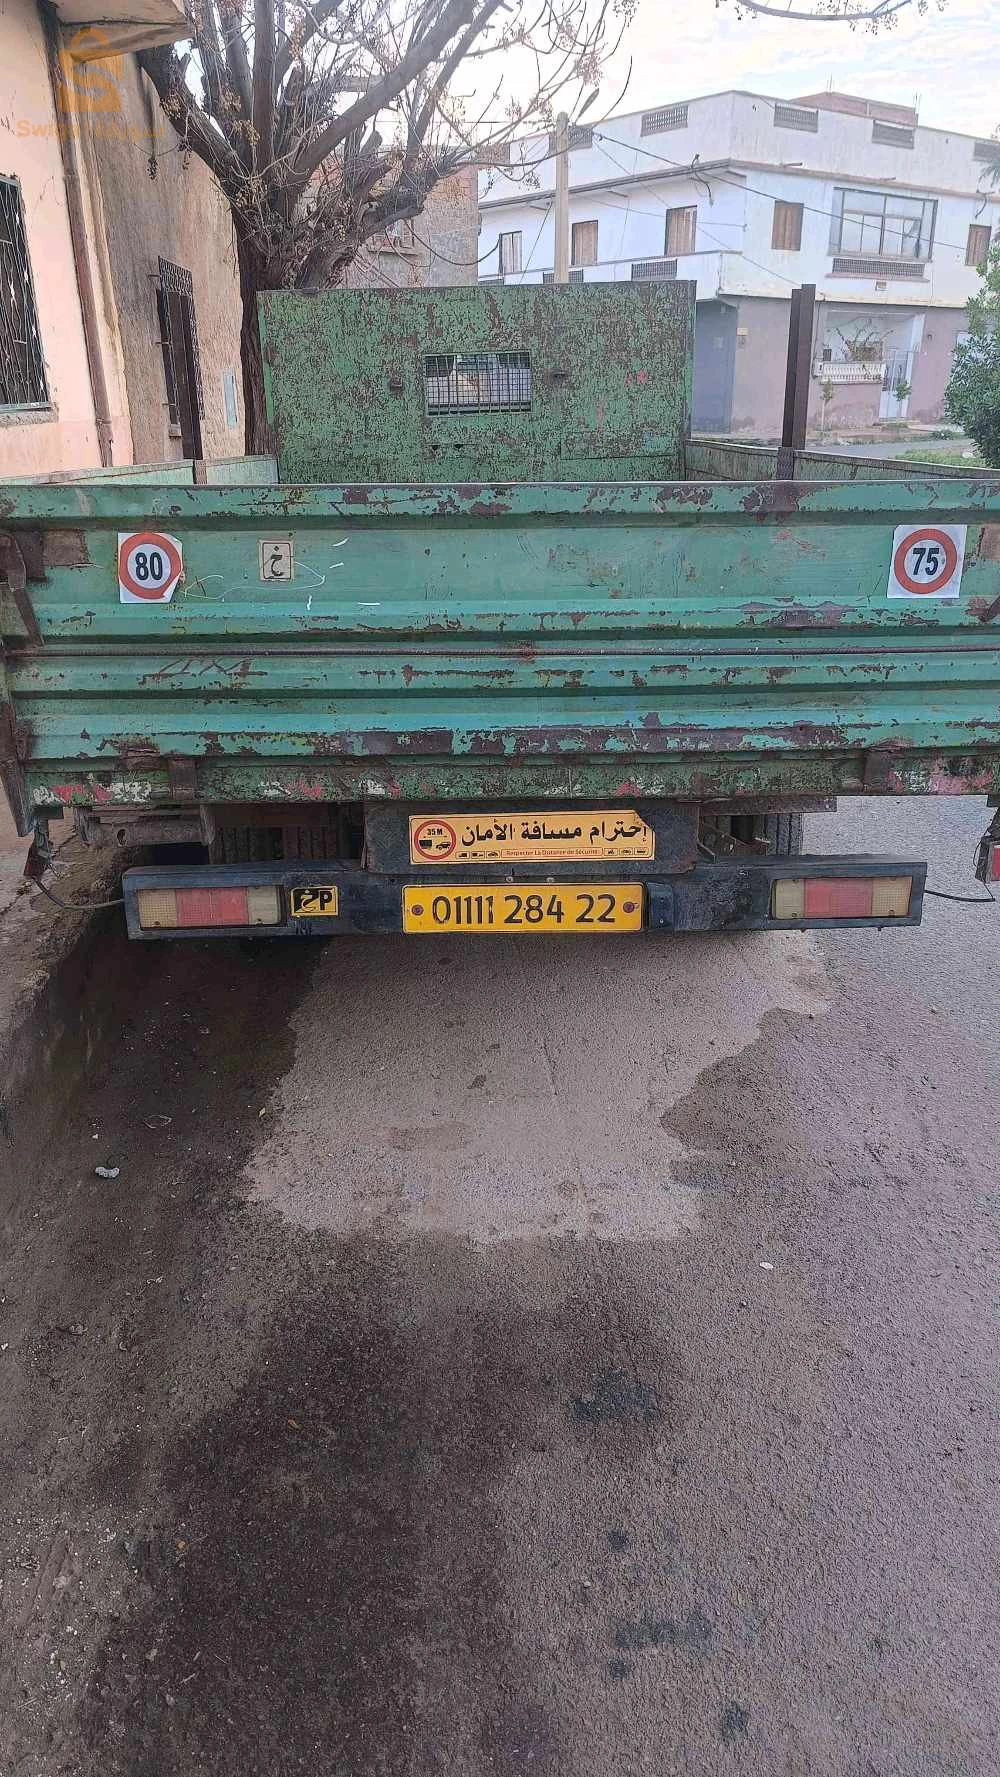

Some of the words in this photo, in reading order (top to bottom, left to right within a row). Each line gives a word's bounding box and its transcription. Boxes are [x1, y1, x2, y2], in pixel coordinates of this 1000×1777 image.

[135, 552, 163, 581] 80
[269, 545, 285, 577] خ
[912, 547, 940, 576] 75
[461, 818, 513, 847] الأمان
[521, 821, 582, 841] مسافة
[589, 820, 647, 844] إحترام
[432, 894, 494, 925] 01111
[504, 894, 564, 924] 284
[576, 893, 616, 924] 22
